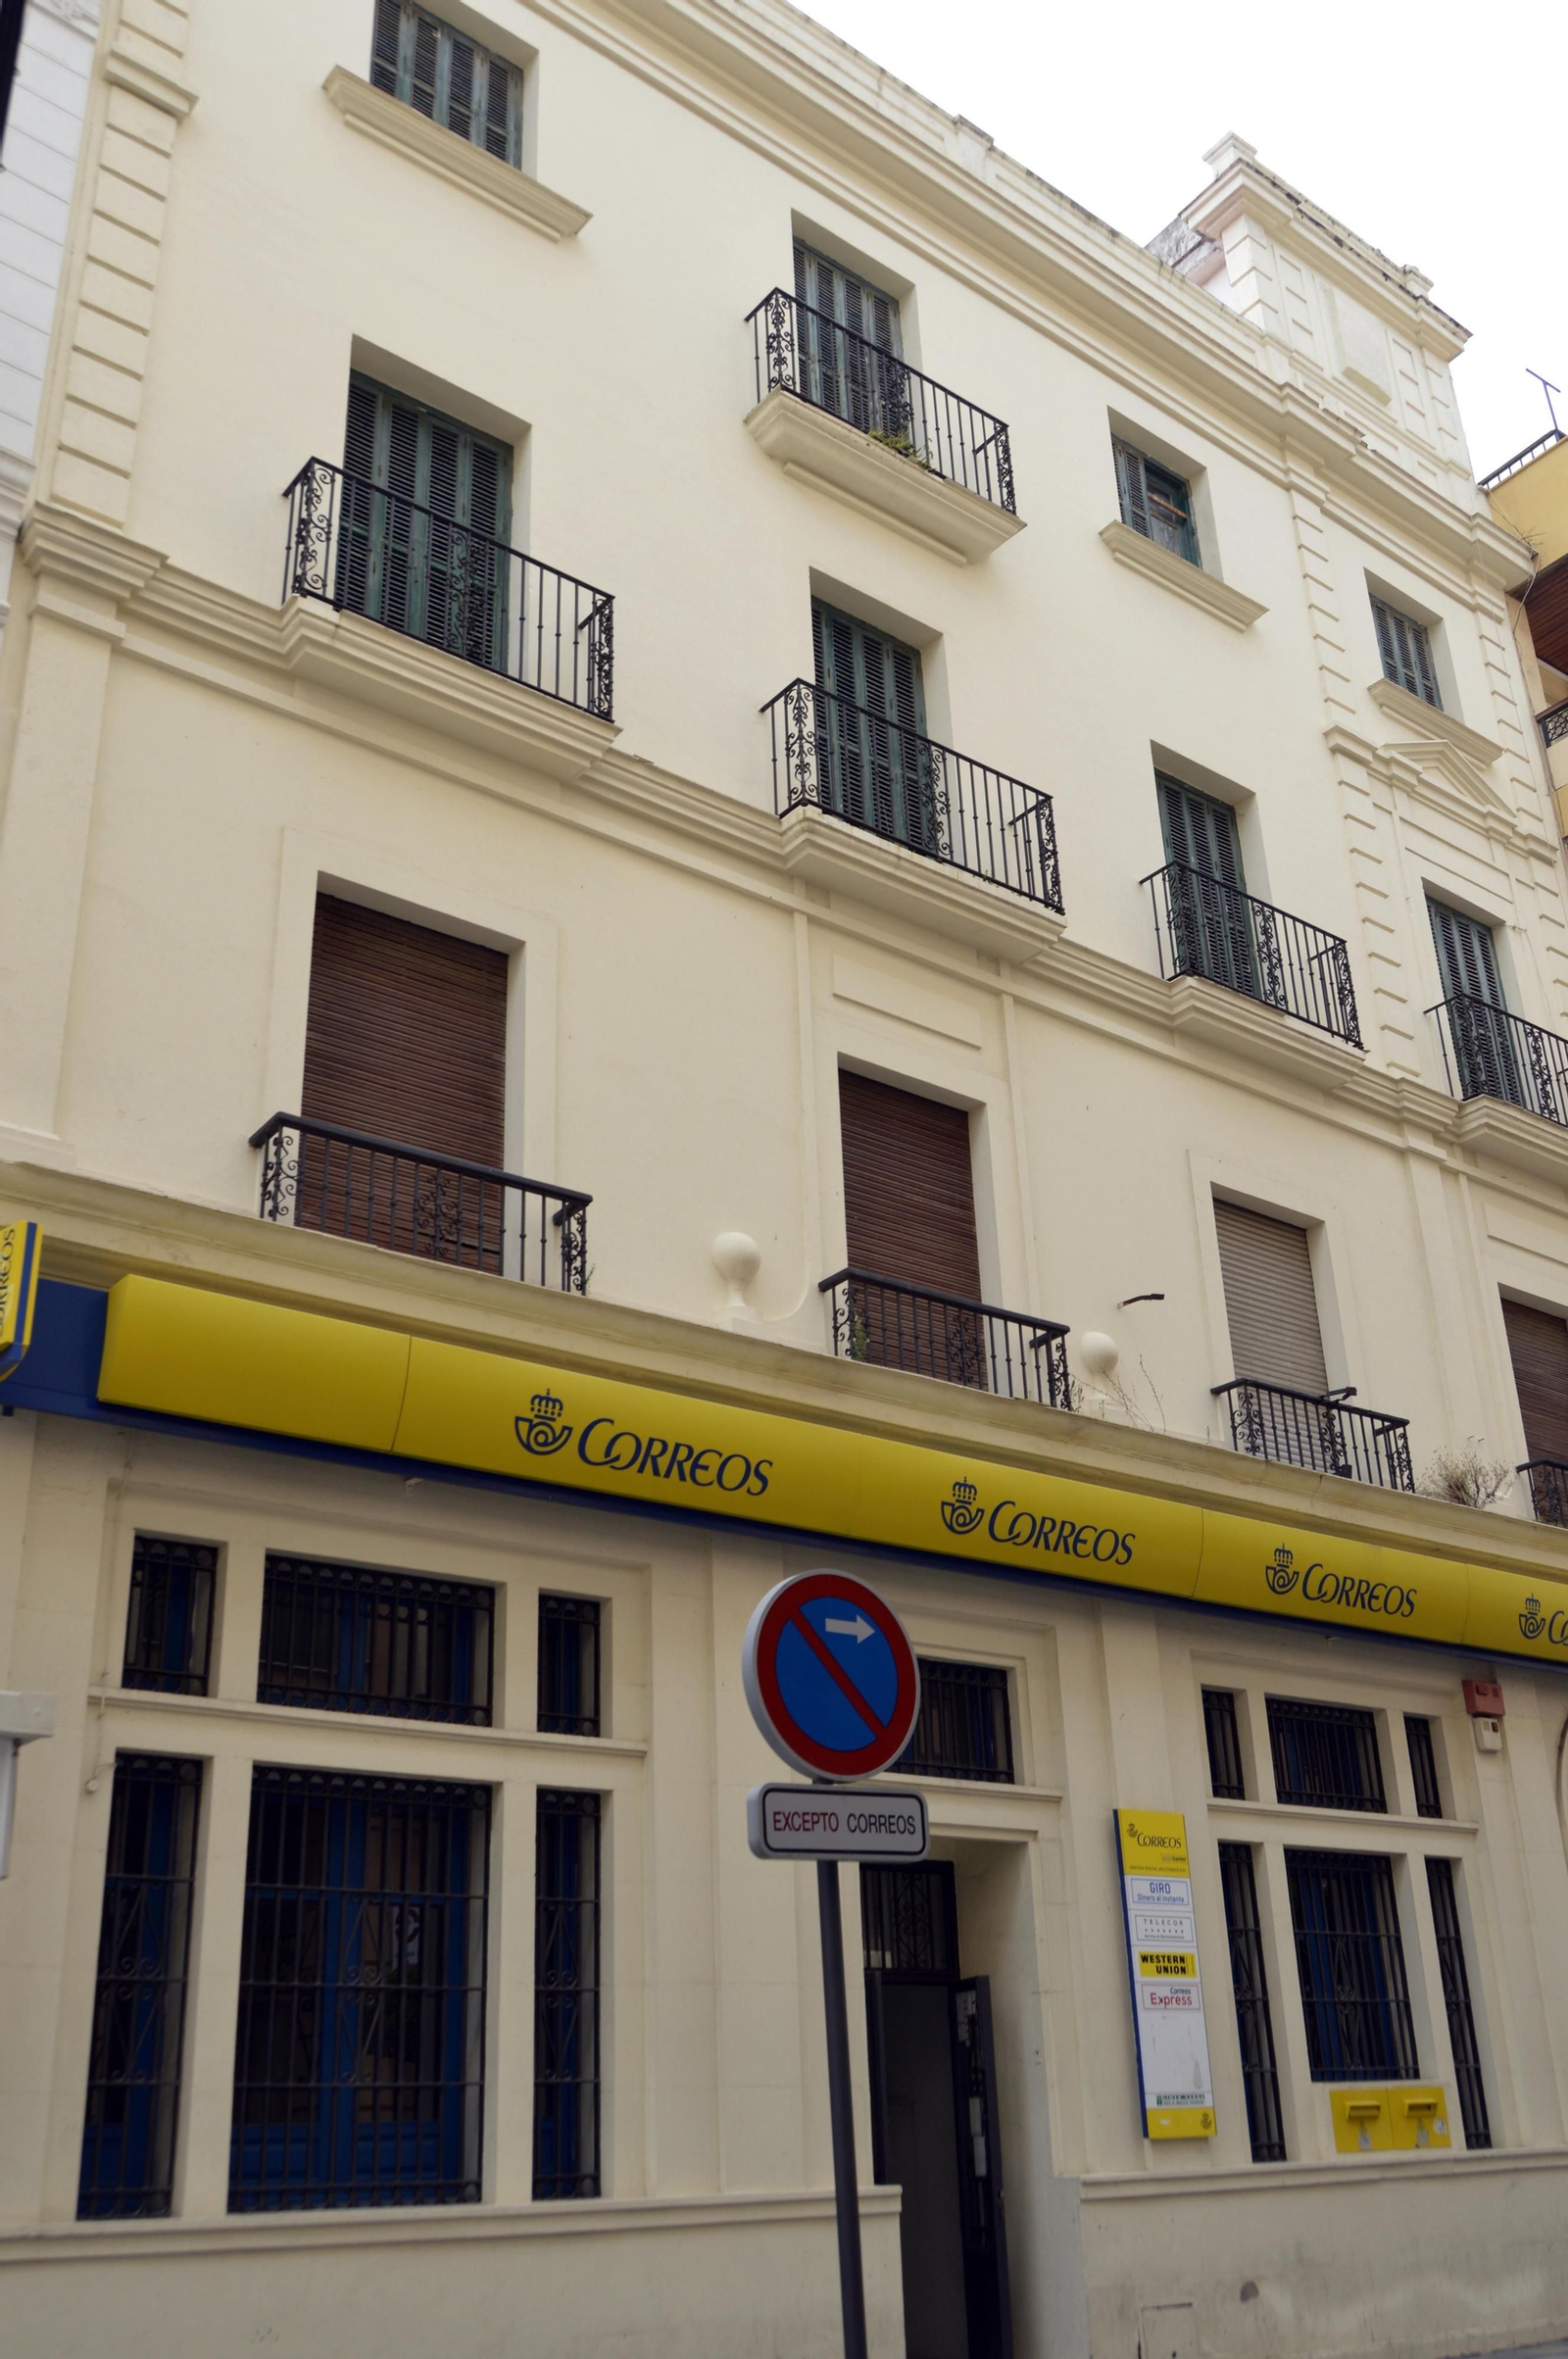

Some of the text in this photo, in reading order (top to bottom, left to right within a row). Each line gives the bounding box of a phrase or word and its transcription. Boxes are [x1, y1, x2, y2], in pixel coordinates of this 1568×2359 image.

[577, 1417, 773, 1497] CORREOS
[988, 1500, 1136, 1565] CORREOS
[1301, 1563, 1417, 1617] CORREOS
[773, 1811, 916, 1836] EXCEPTO CORREOS
[1137, 1832, 1182, 1849] CORREOS
[1150, 1882, 1171, 1893] GIRO
[1144, 1918, 1183, 1927] TELECOR
[1141, 1954, 1186, 1964] WESTERN
[1155, 1965, 1187, 1975] UNION
[1169, 1987, 1192, 1995] Correos
[1150, 1992, 1193, 2009] Express
